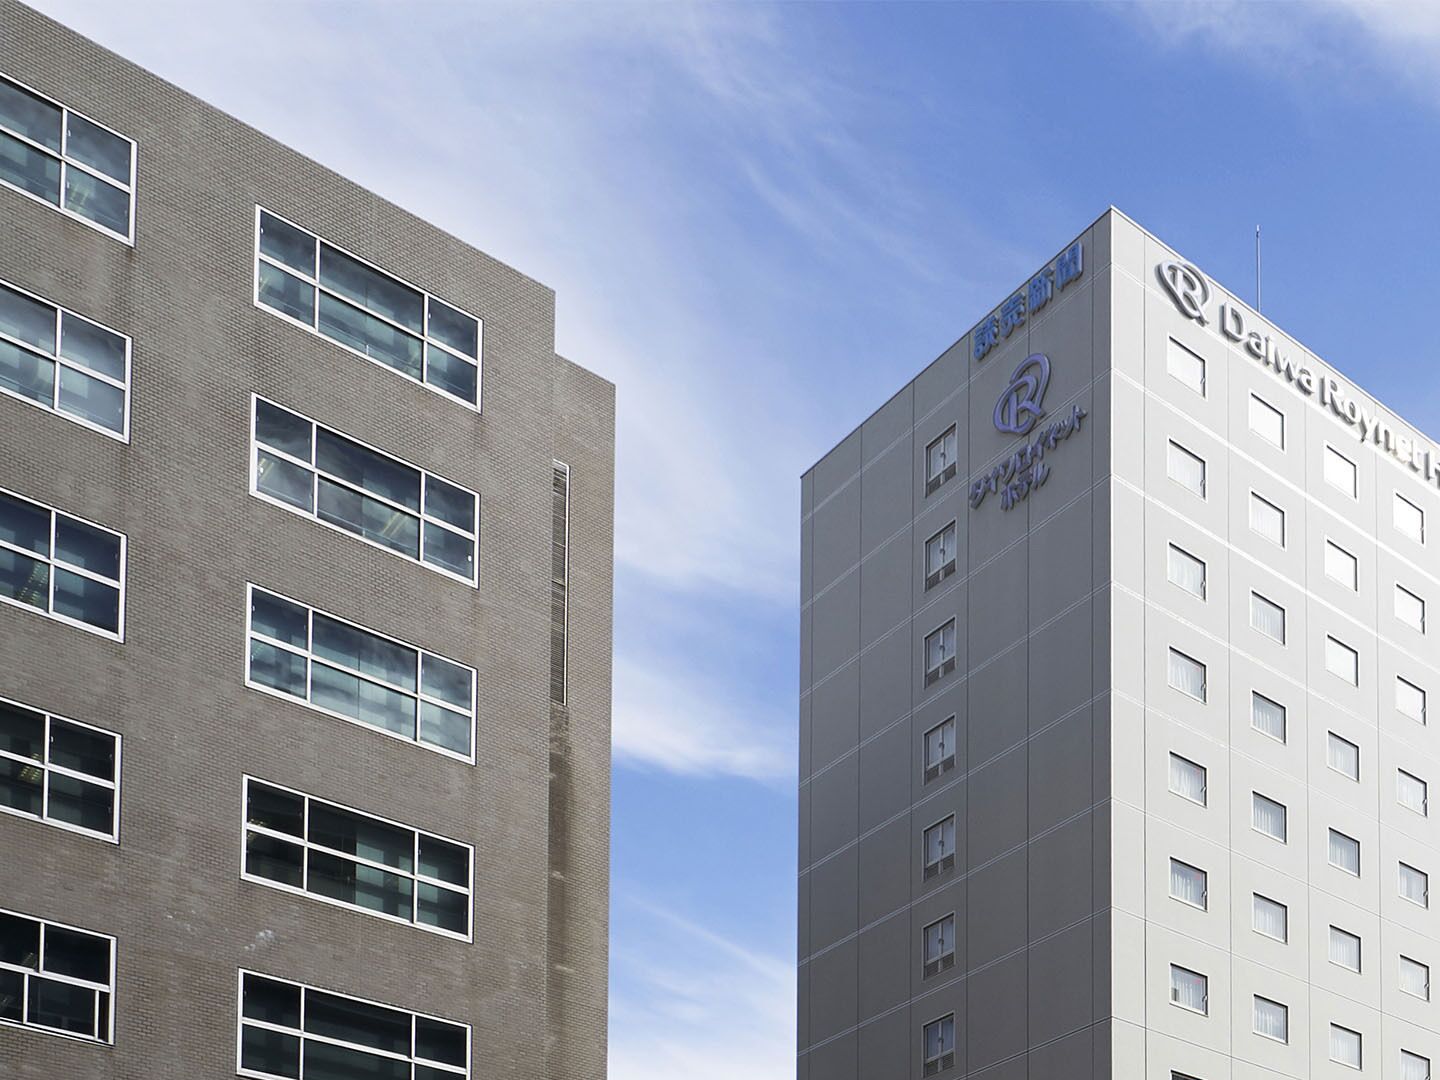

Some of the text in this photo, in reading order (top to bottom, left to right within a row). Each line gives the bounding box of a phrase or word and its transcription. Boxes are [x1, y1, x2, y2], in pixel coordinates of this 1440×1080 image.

[974, 241, 1084, 361] 読売新聞
[1219, 301, 1315, 396] Daiwa
[1319, 374, 1426, 473] Roynet
[969, 404, 1088, 510] ダイワロイネット
[1000, 463, 1051, 512] ホテル
